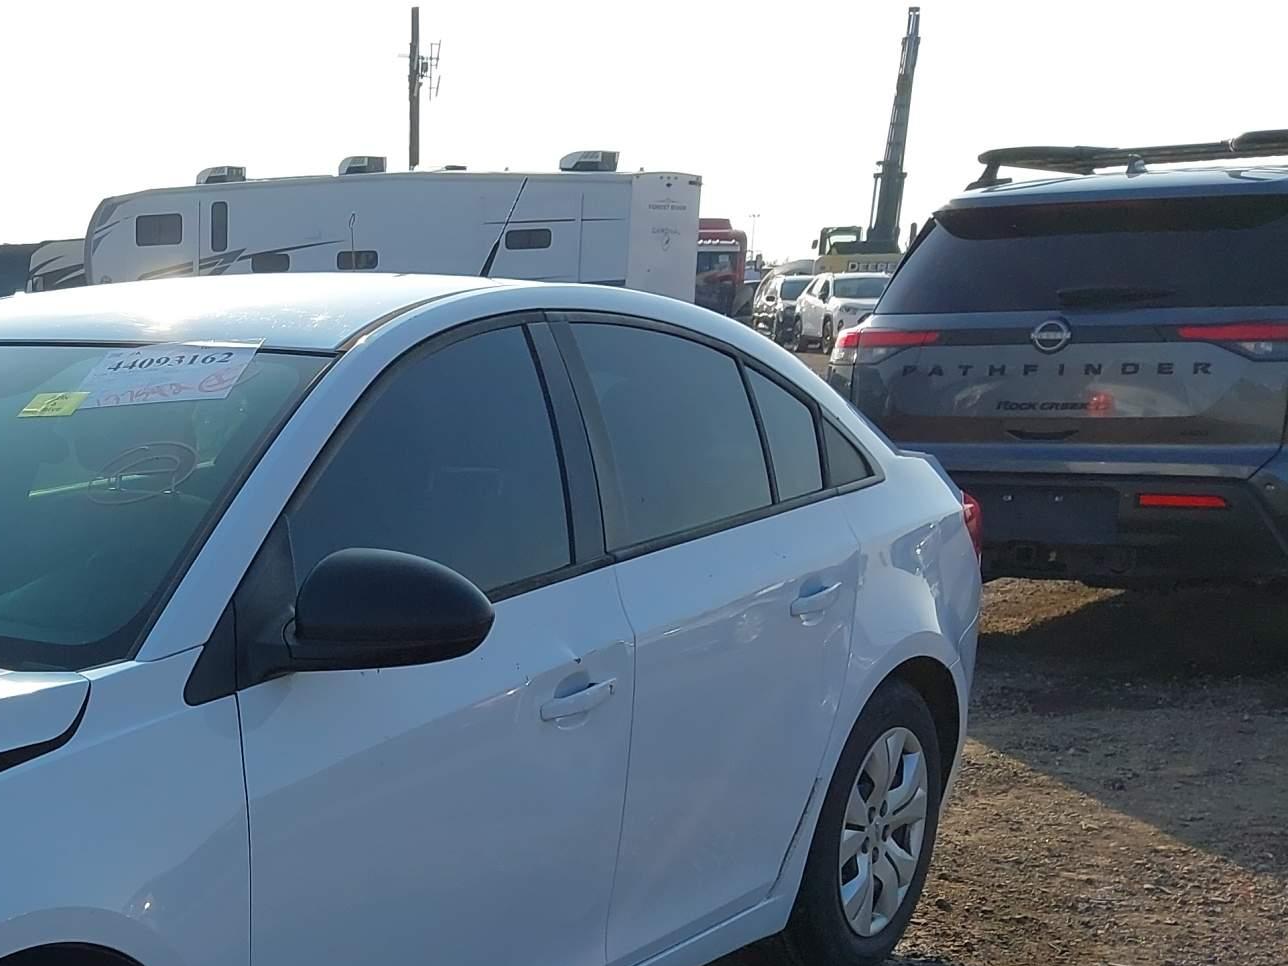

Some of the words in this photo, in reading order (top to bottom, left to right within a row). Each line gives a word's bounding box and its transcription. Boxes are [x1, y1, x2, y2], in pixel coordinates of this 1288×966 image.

[847, 261, 898, 272] DEERE
[107, 352, 234, 372] 44093162
[902, 362, 1213, 377] PATHFINDER
